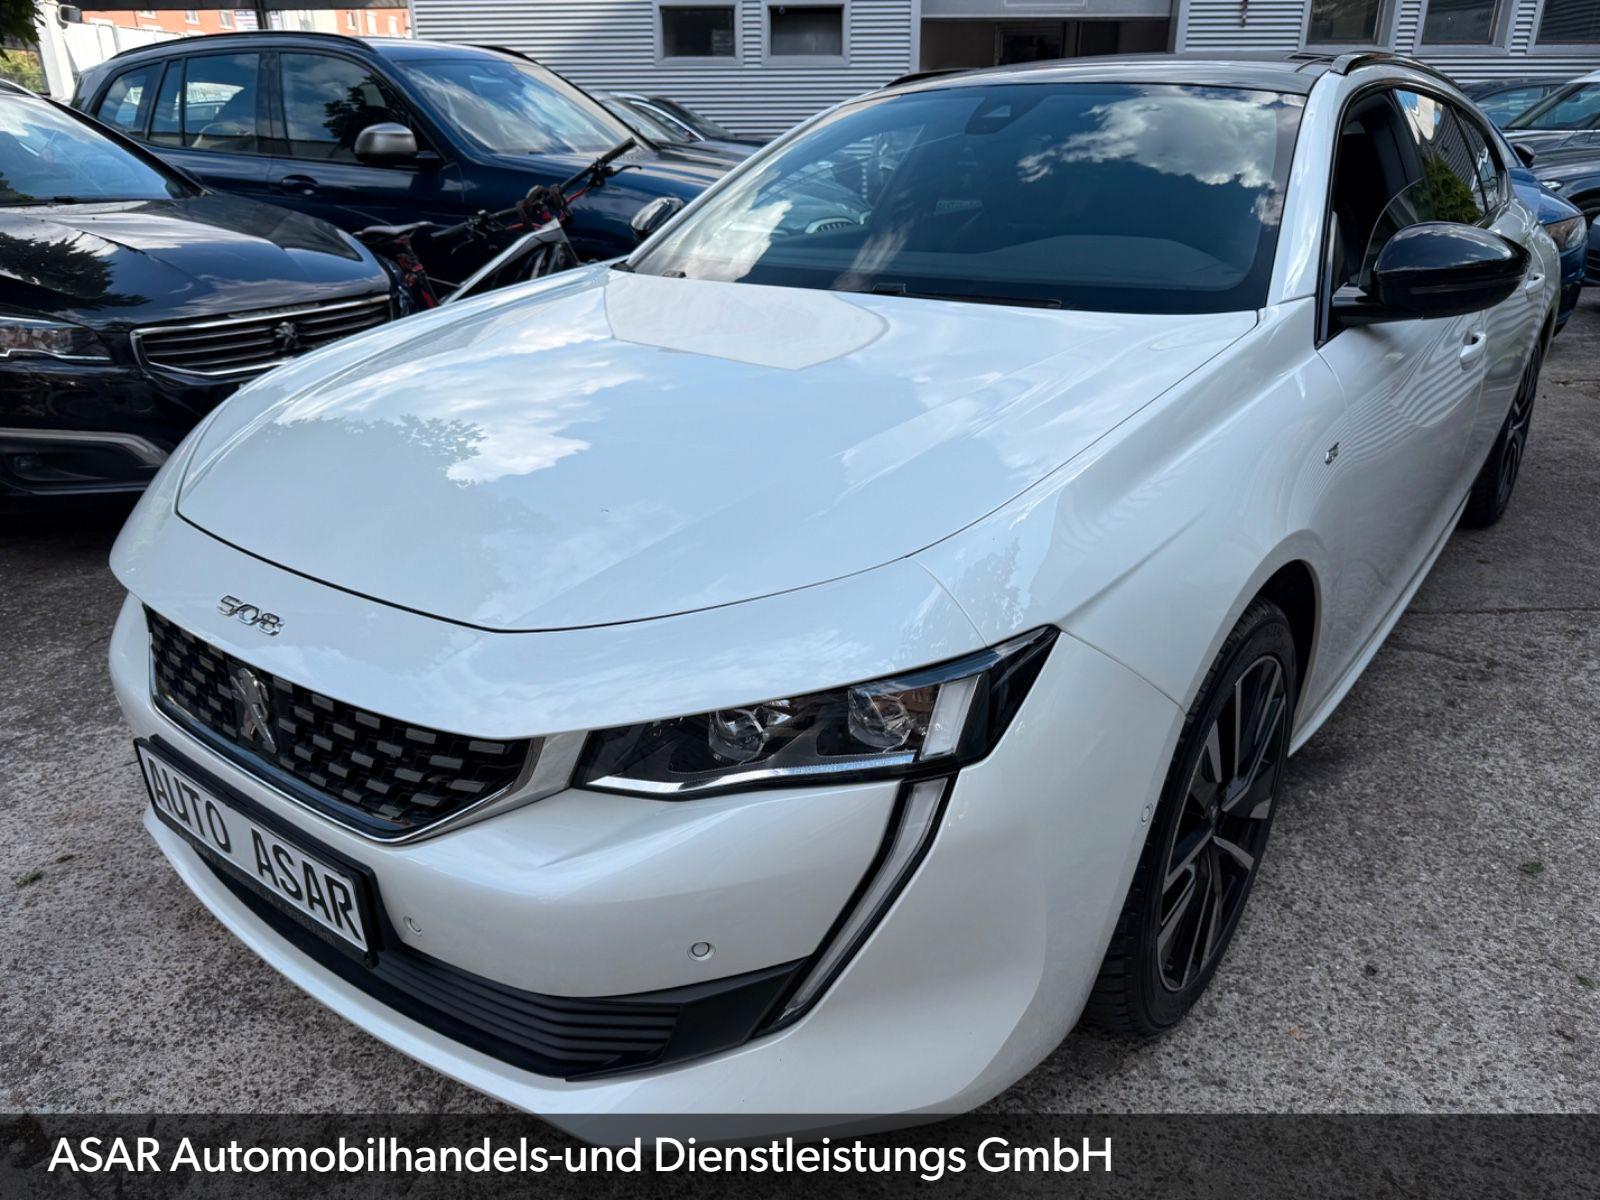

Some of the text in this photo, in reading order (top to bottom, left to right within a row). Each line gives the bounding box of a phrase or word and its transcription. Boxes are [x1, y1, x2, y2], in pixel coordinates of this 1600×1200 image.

[217, 595, 284, 636] 508
[147, 757, 232, 854] AUTO
[251, 826, 362, 942] ASAR
